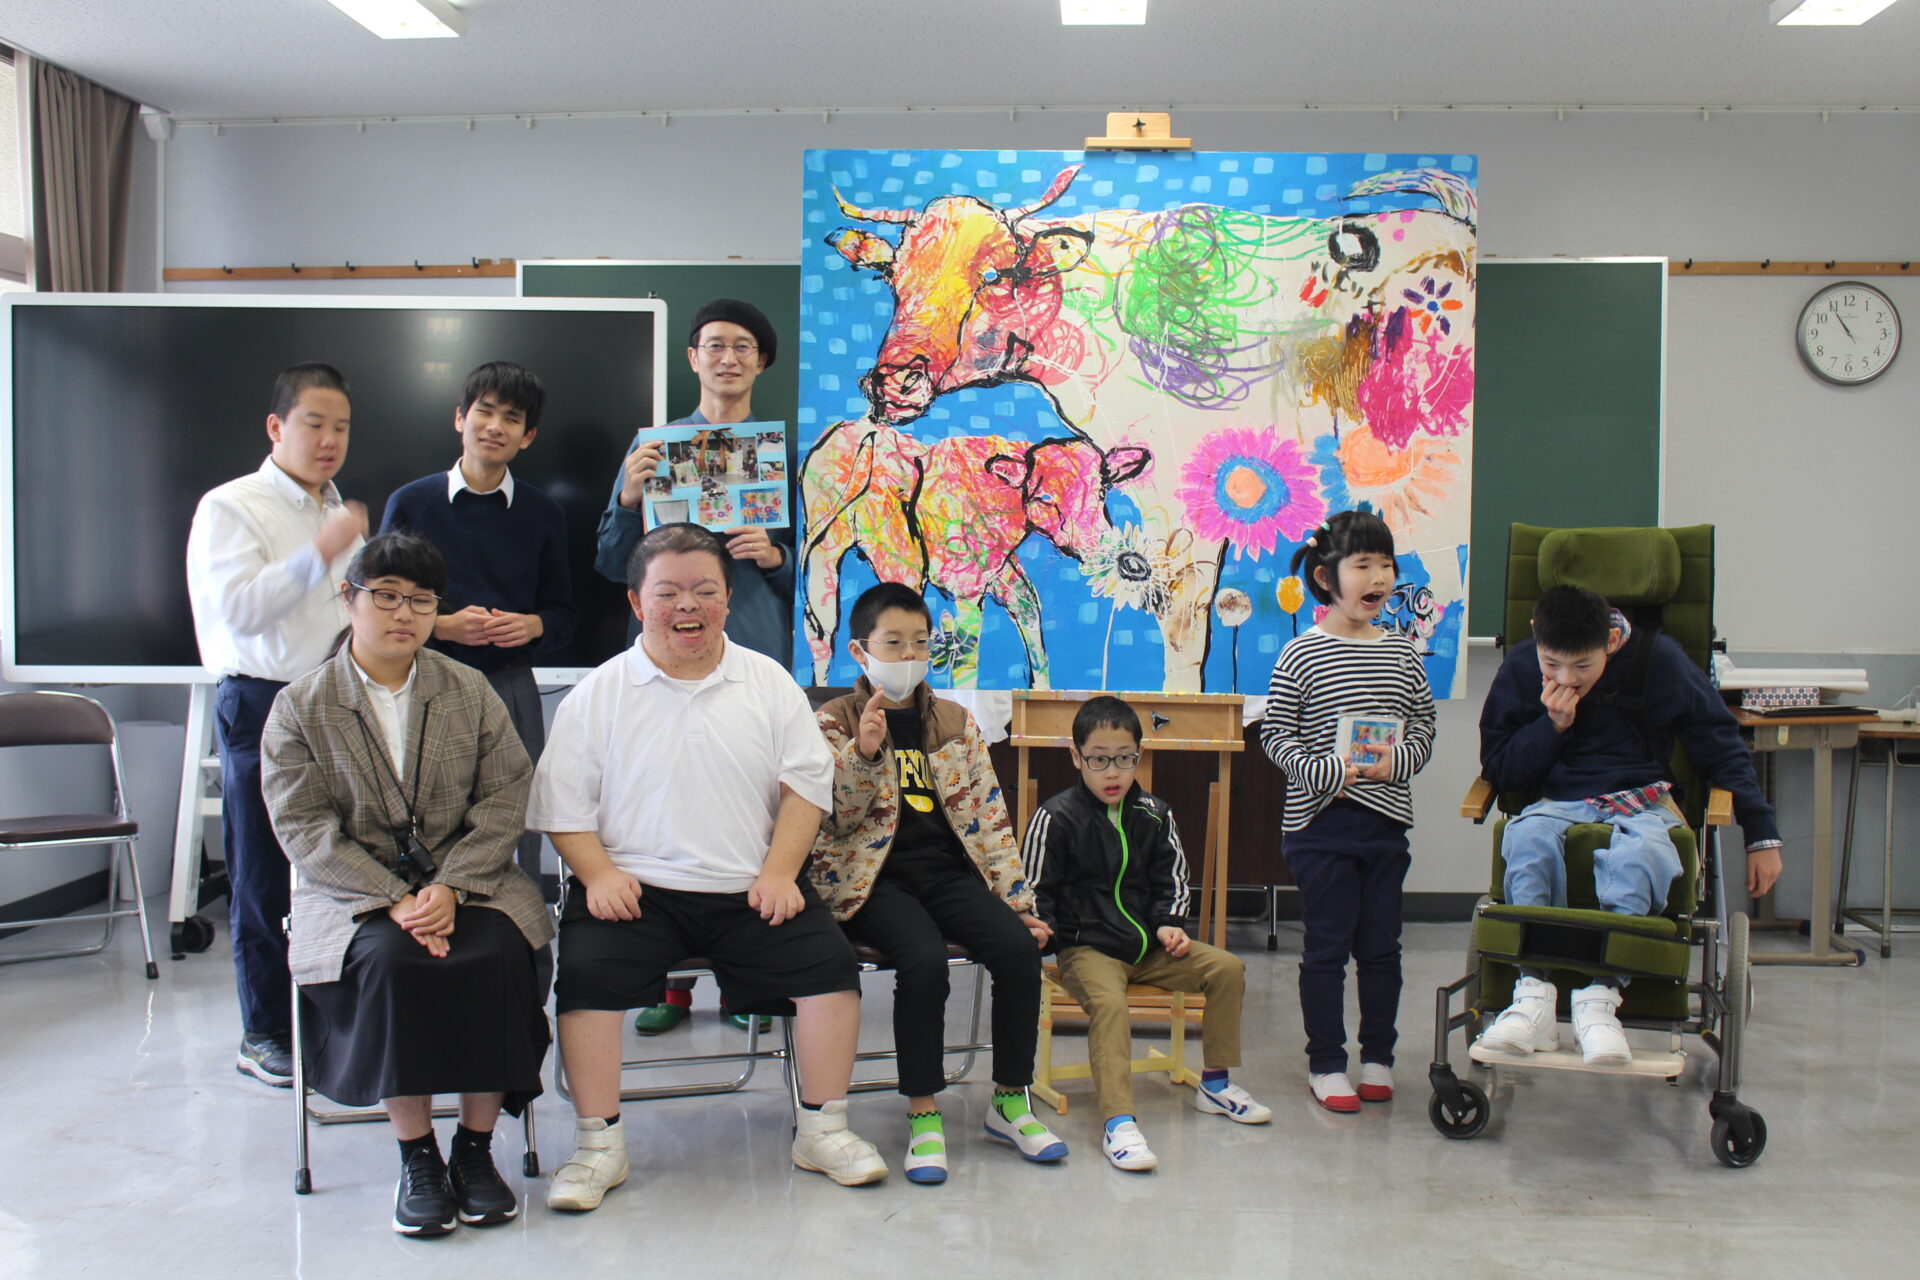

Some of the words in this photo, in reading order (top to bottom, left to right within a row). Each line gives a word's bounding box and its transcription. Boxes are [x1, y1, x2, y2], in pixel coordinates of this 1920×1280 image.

[1829, 300, 1838, 312] 11
[1843, 295, 1856, 307] 12
[1816, 312, 1828, 324] 10
[1875, 312, 1883, 323] 2
[1811, 329, 1819, 340] 9
[1880, 328, 1887, 340] 3
[1816, 345, 1824, 357] 8
[1873, 345, 1881, 357] 4
[1830, 356, 1838, 368] 7
[1844, 361, 1852, 372] 6
[1862, 356, 1869, 368] 5
